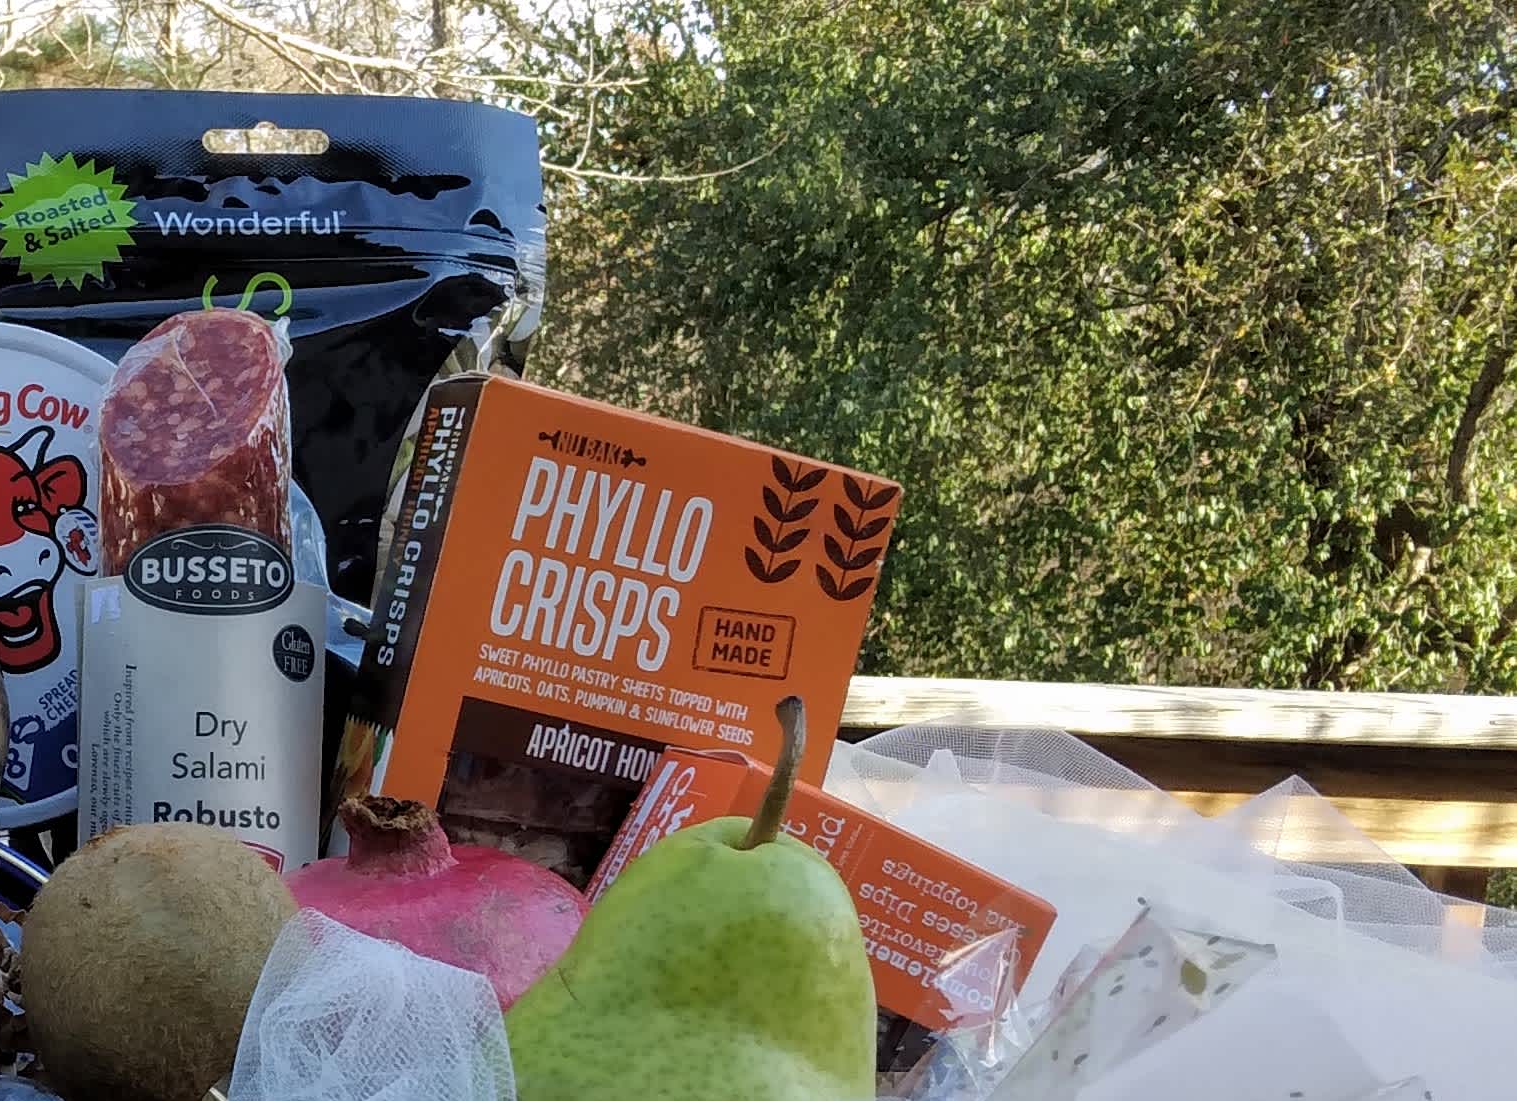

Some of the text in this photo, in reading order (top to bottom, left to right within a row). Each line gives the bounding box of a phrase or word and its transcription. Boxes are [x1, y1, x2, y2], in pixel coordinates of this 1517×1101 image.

[14, 187, 108, 229] Roasted
[153, 210, 342, 237] Wonderful
[24, 209, 117, 253] & Salted
[16, 383, 90, 430] Cow
[413, 407, 456, 530] PHYLLO
[512, 455, 713, 583] PHYLLO
[141, 556, 285, 587] BUSSETO
[175, 589, 256, 601] FOODS
[378, 541, 421, 666] CRISPS
[490, 549, 680, 673] CRISPS
[713, 618, 776, 643] HAND
[284, 656, 308, 675] FREE
[711, 642, 772, 667] MADE
[123, 664, 137, 713] Inspired
[479, 644, 748, 721] SWEET PHYLLO PASTRY SHEETS TOPPED WITH
[123, 715, 135, 747] from
[195, 711, 248, 746] Dry
[574, 691, 626, 716] PUMPKIN
[629, 704, 641, 721] &
[645, 706, 714, 736] SUNFLOWER
[718, 722, 754, 745] SEEDS
[171, 751, 266, 781] Salami
[526, 720, 664, 783] APRICOT HON
[153, 800, 281, 829] Robusto
[858, 882, 917, 925] Dips
[882, 858, 979, 918] toppings
